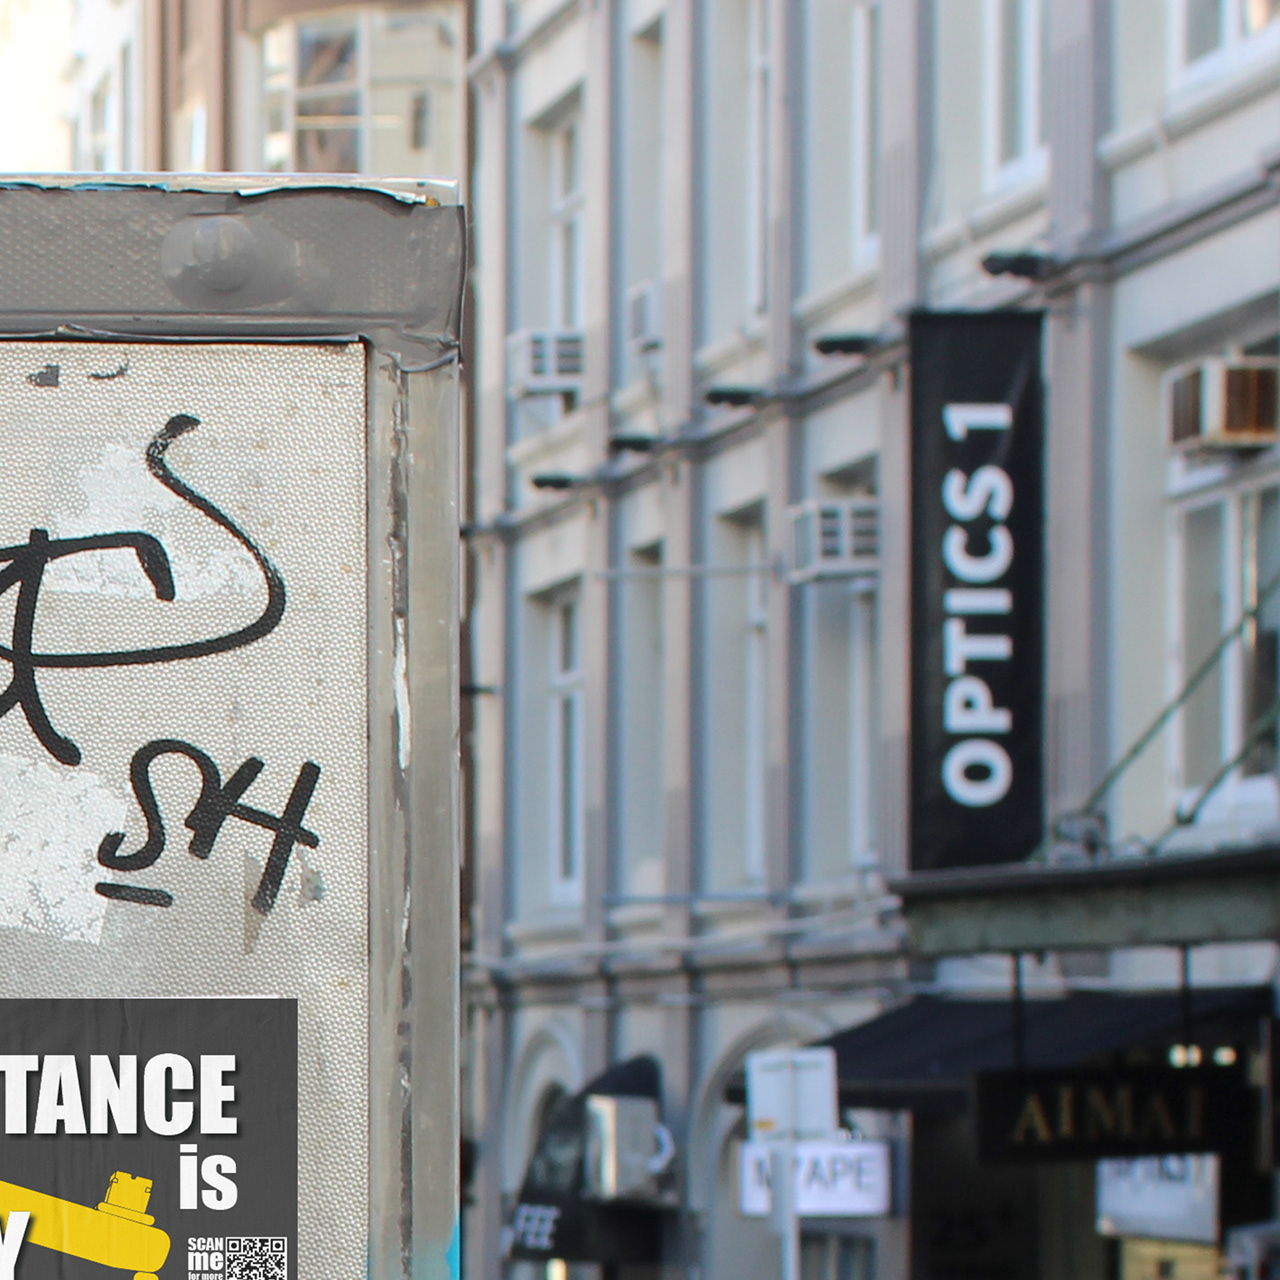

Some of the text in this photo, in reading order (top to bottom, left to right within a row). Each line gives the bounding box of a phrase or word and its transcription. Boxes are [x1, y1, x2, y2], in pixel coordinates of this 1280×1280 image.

[941, 401, 1015, 808] OPTICS 1
[179, 1143, 238, 1211] is
[187, 1237, 224, 1251] SCAN
[187, 1251, 224, 1271] me
[187, 1271, 224, 1280] for more
